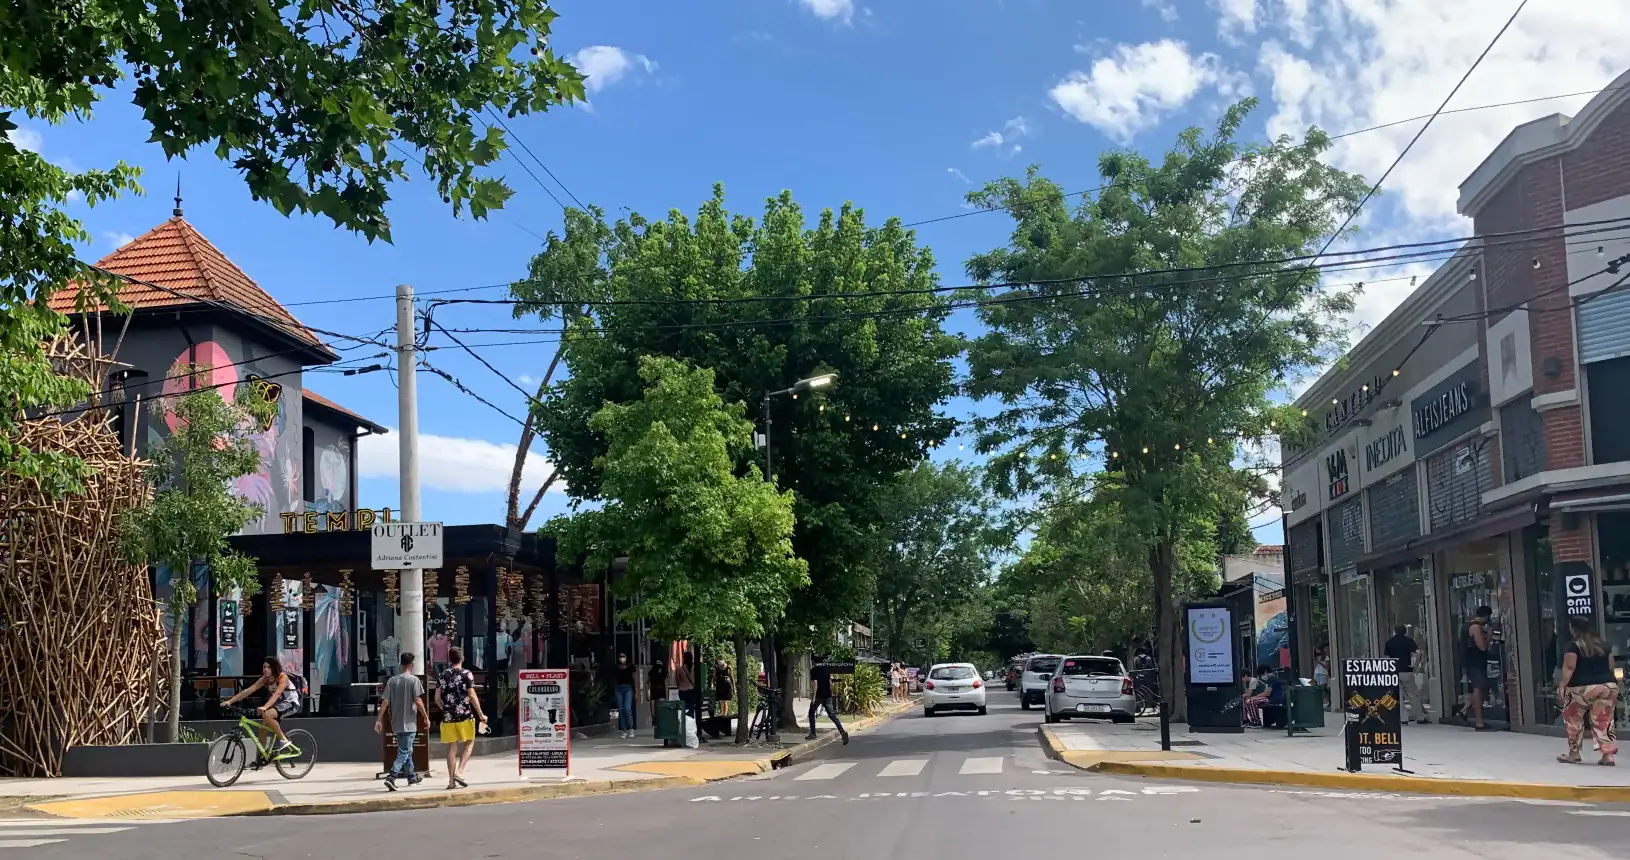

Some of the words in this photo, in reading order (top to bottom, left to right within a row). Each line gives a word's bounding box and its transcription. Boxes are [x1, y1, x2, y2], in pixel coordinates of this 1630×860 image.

[1415, 381, 1468, 439] ALFISJEANS
[1365, 427, 1407, 472] INEDITA
[374, 523, 441, 538] OUTLET
[376, 554, 402, 562] Adriana
[1346, 659, 1397, 673] ESTAMOS
[1345, 674, 1399, 687] TATUANDO
[1374, 732, 1400, 745] BELL
